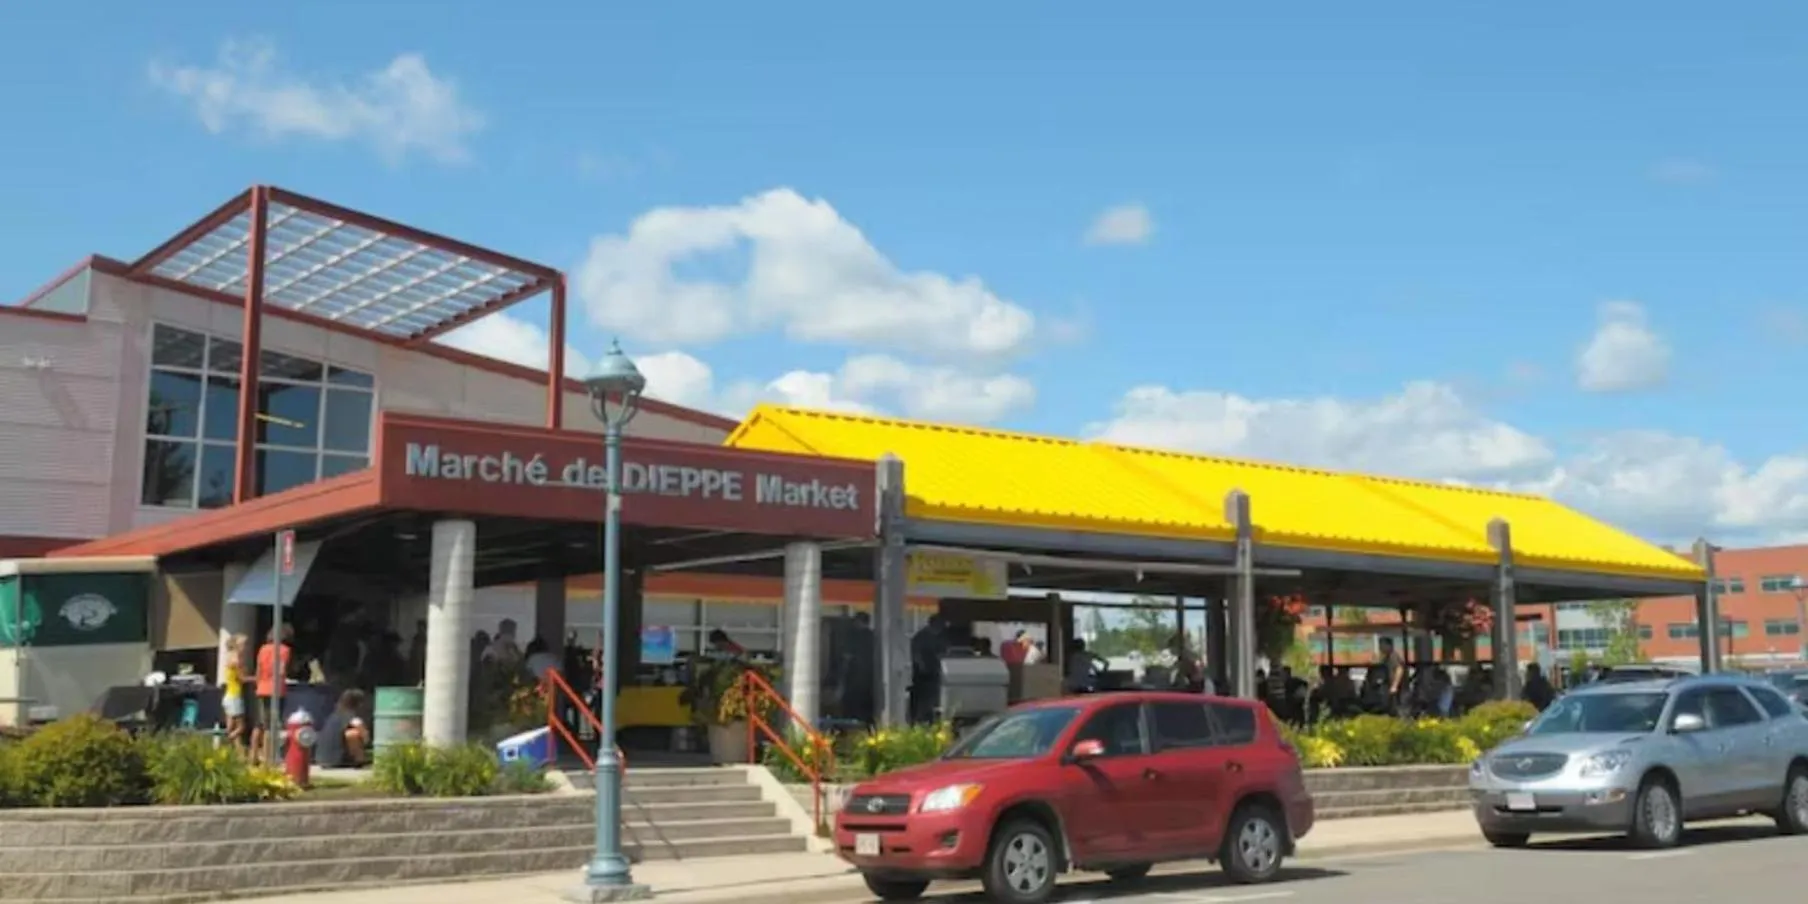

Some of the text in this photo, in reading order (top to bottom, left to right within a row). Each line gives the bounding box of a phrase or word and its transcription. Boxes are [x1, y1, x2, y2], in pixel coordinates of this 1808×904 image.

[405, 442, 860, 510] Marché de DIEPPE Market
